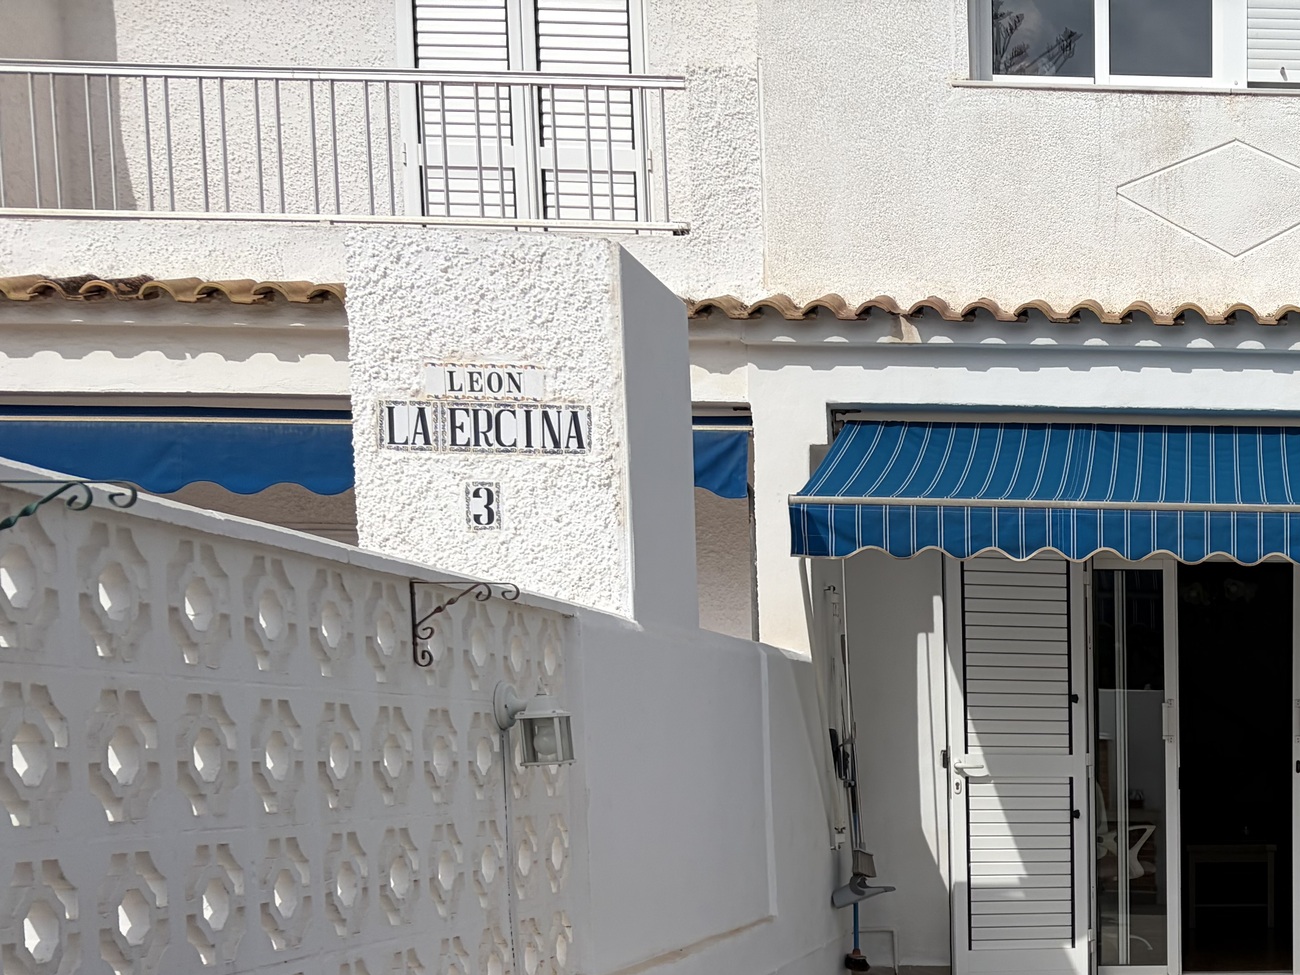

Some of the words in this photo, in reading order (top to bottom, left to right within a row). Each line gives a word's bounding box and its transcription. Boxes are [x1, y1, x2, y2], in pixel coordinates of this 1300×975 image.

[447, 370, 523, 393] LEON
[387, 406, 432, 446] LA
[448, 408, 586, 450] ERCINA
[472, 487, 495, 526] 3
